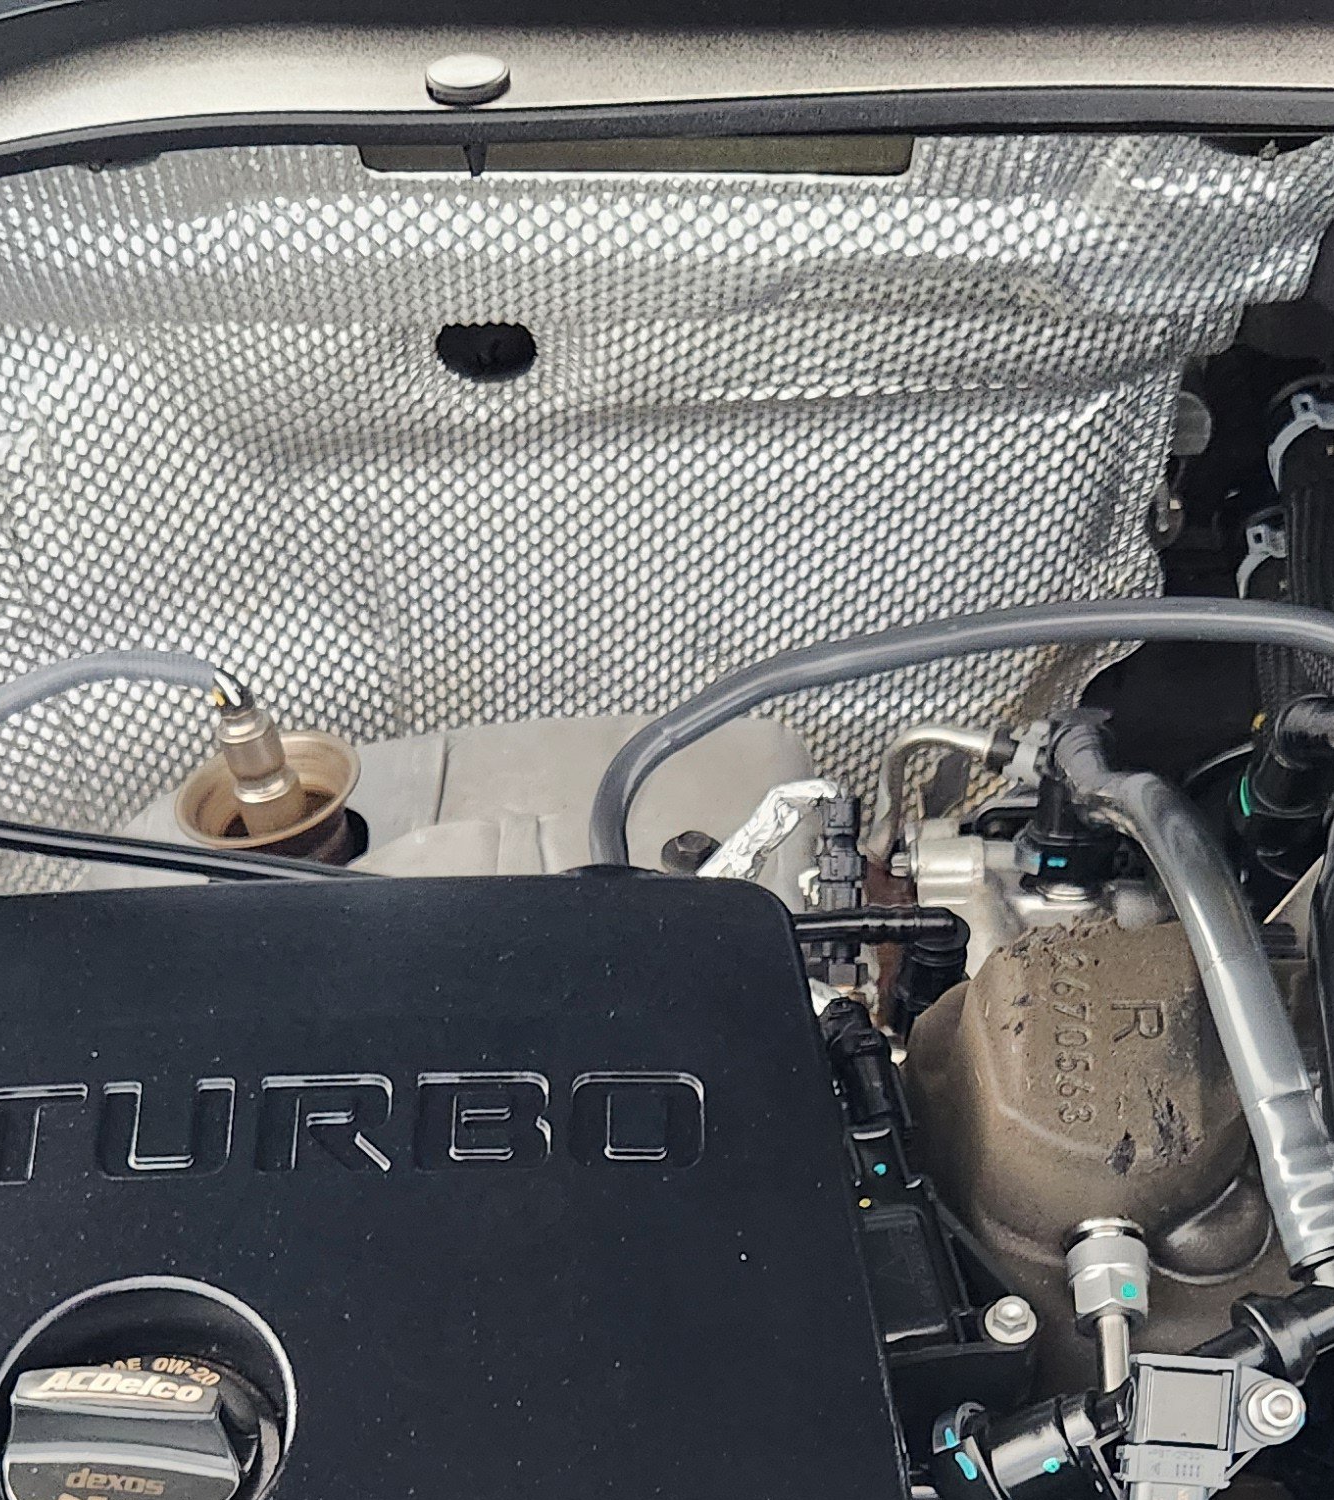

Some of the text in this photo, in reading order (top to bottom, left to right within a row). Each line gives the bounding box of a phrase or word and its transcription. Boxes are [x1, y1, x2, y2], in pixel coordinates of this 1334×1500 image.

[1110, 1000, 1167, 1043] R
[37, 1370, 204, 1403] ACDelco
[151, 1356, 222, 1387] 0W-20
[64, 1467, 166, 1496] dexos
